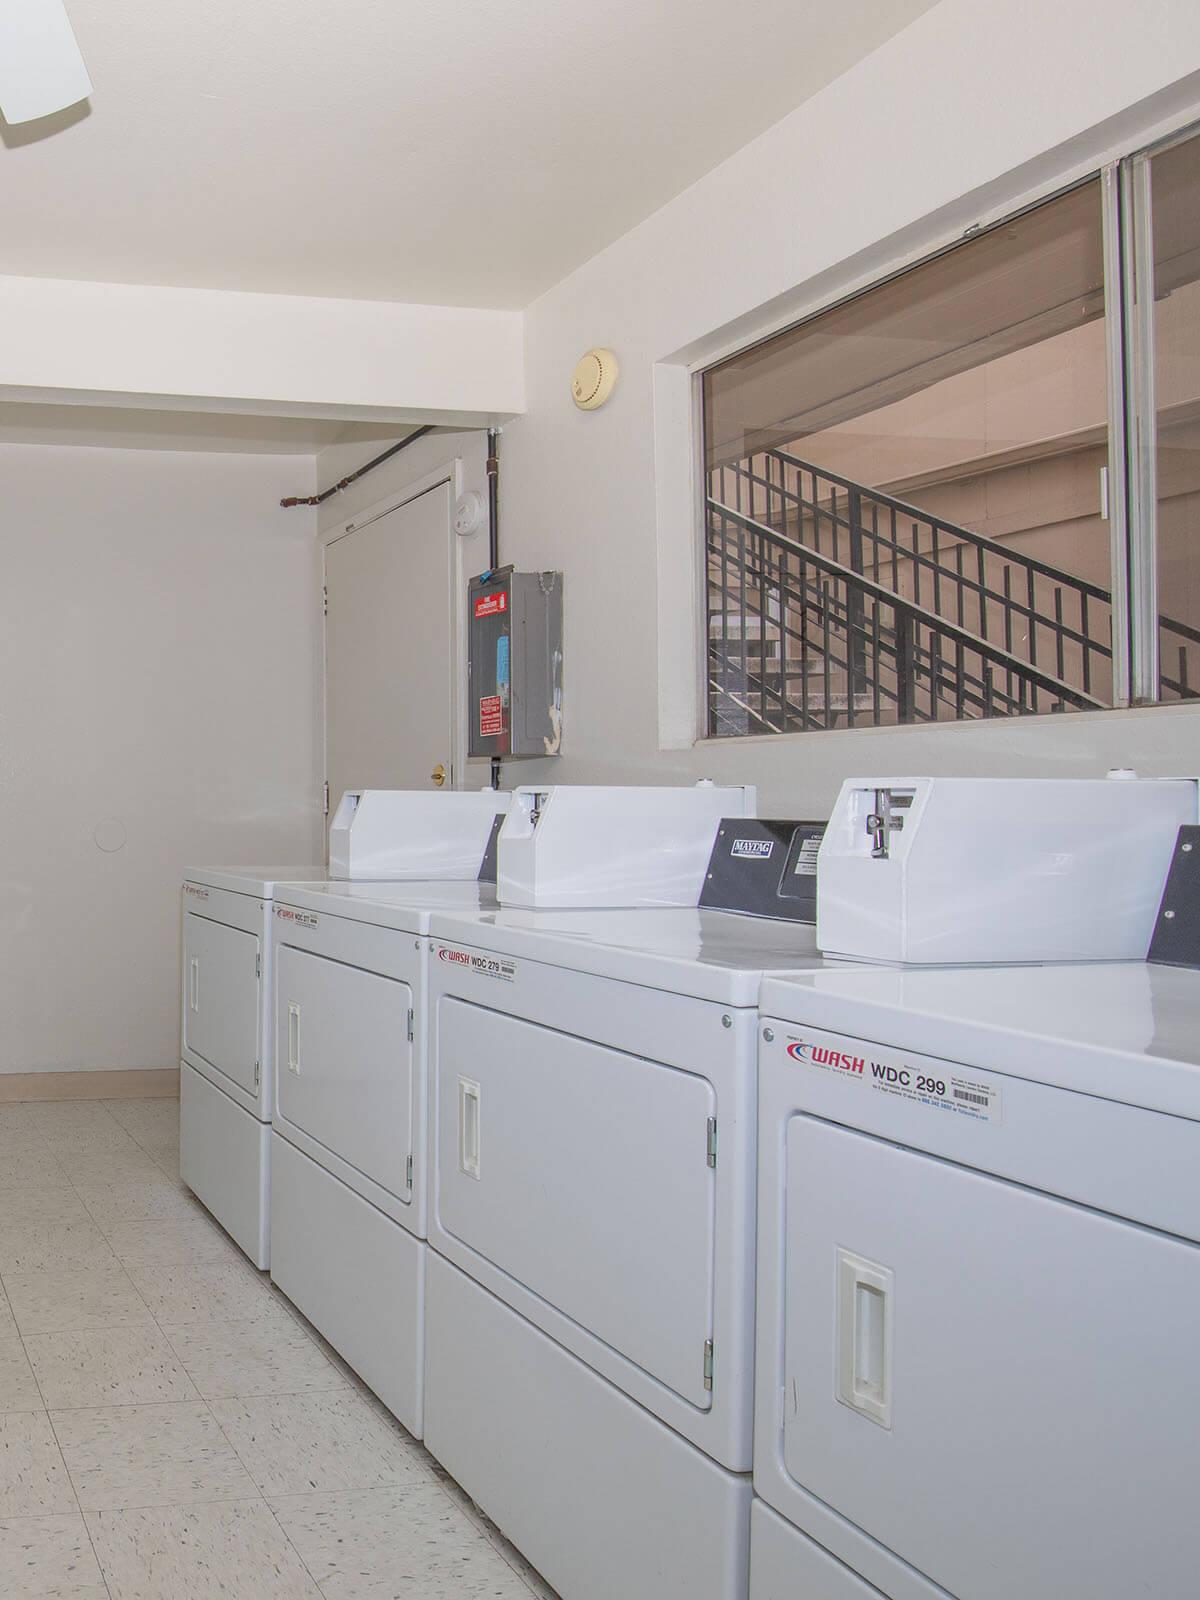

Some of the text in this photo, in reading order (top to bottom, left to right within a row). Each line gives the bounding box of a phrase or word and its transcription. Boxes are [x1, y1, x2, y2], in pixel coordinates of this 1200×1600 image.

[734, 841, 770, 851] MAYTAG
[448, 951, 470, 964] WASH
[471, 957, 487, 968] WDC
[488, 961, 499, 972] 279
[811, 1046, 865, 1073] WASH
[870, 1062, 911, 1086] WDC
[916, 1075, 946, 1096] 299
